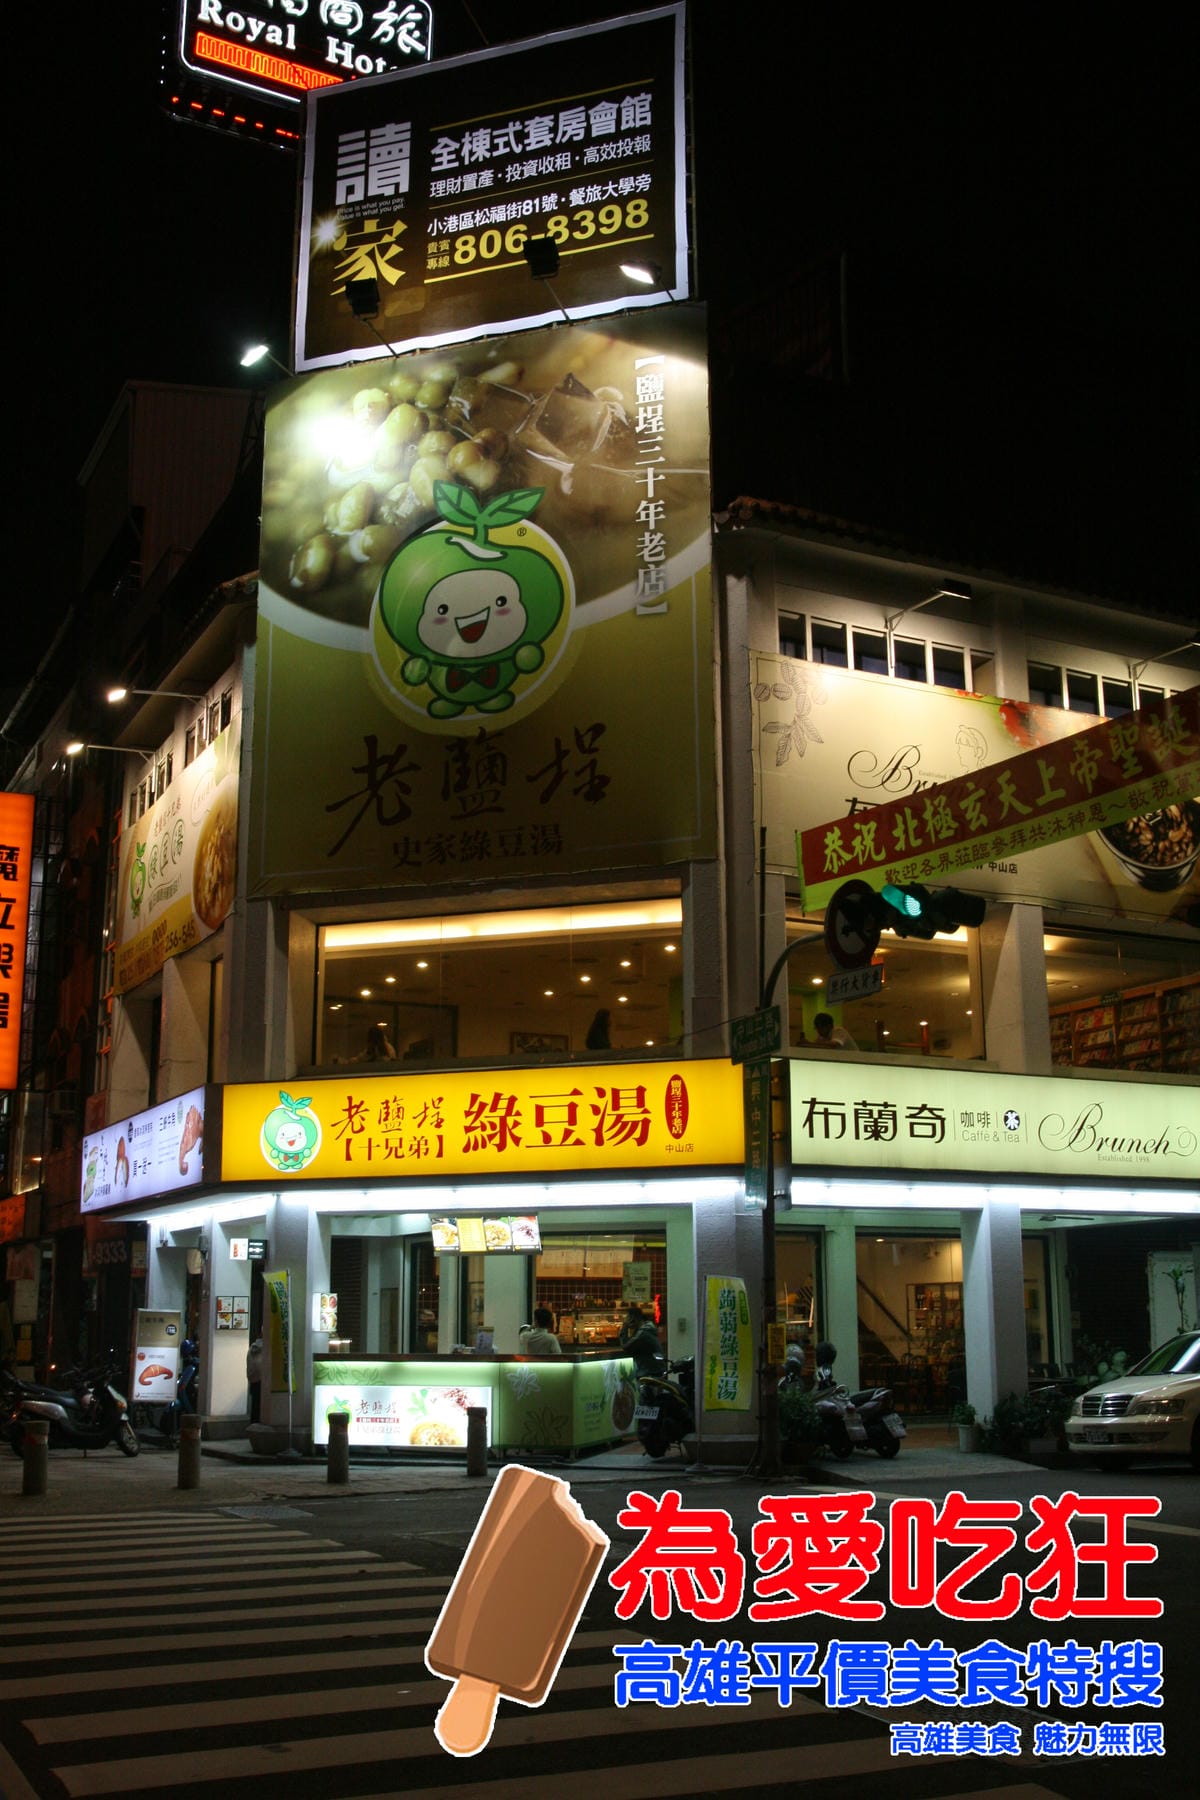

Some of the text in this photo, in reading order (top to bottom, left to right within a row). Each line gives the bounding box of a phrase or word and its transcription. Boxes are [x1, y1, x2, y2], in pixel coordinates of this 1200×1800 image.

[197, 0, 399, 76] Royal Hot
[430, 92, 652, 172] 全棟式套房會館
[361, 201, 378, 210] what
[378, 201, 391, 209] you
[362, 207, 378, 216] what
[379, 206, 392, 214] you
[427, 238, 450, 255] 貴賓
[453, 198, 649, 265] 806-8398
[330, 218, 409, 296] 家
[426, 256, 450, 271] 專線
[325, 722, 611, 858] 老鹽埕
[392, 822, 564, 869] 史家綠豆湯
[988, 862, 1018, 875] 中山店
[330, 1095, 446, 1140] 老鹽埕
[462, 1084, 652, 1154] 綠豆湯
[801, 1097, 947, 1144] 布蘭奇
[960, 1110, 1020, 1130] 咖啡 茶
[992, 1131, 1000, 1142] &
[1002, 1131, 1020, 1143] Tea
[1038, 1101, 1198, 1157] Brunch
[665, 1144, 694, 1153] 中山店
